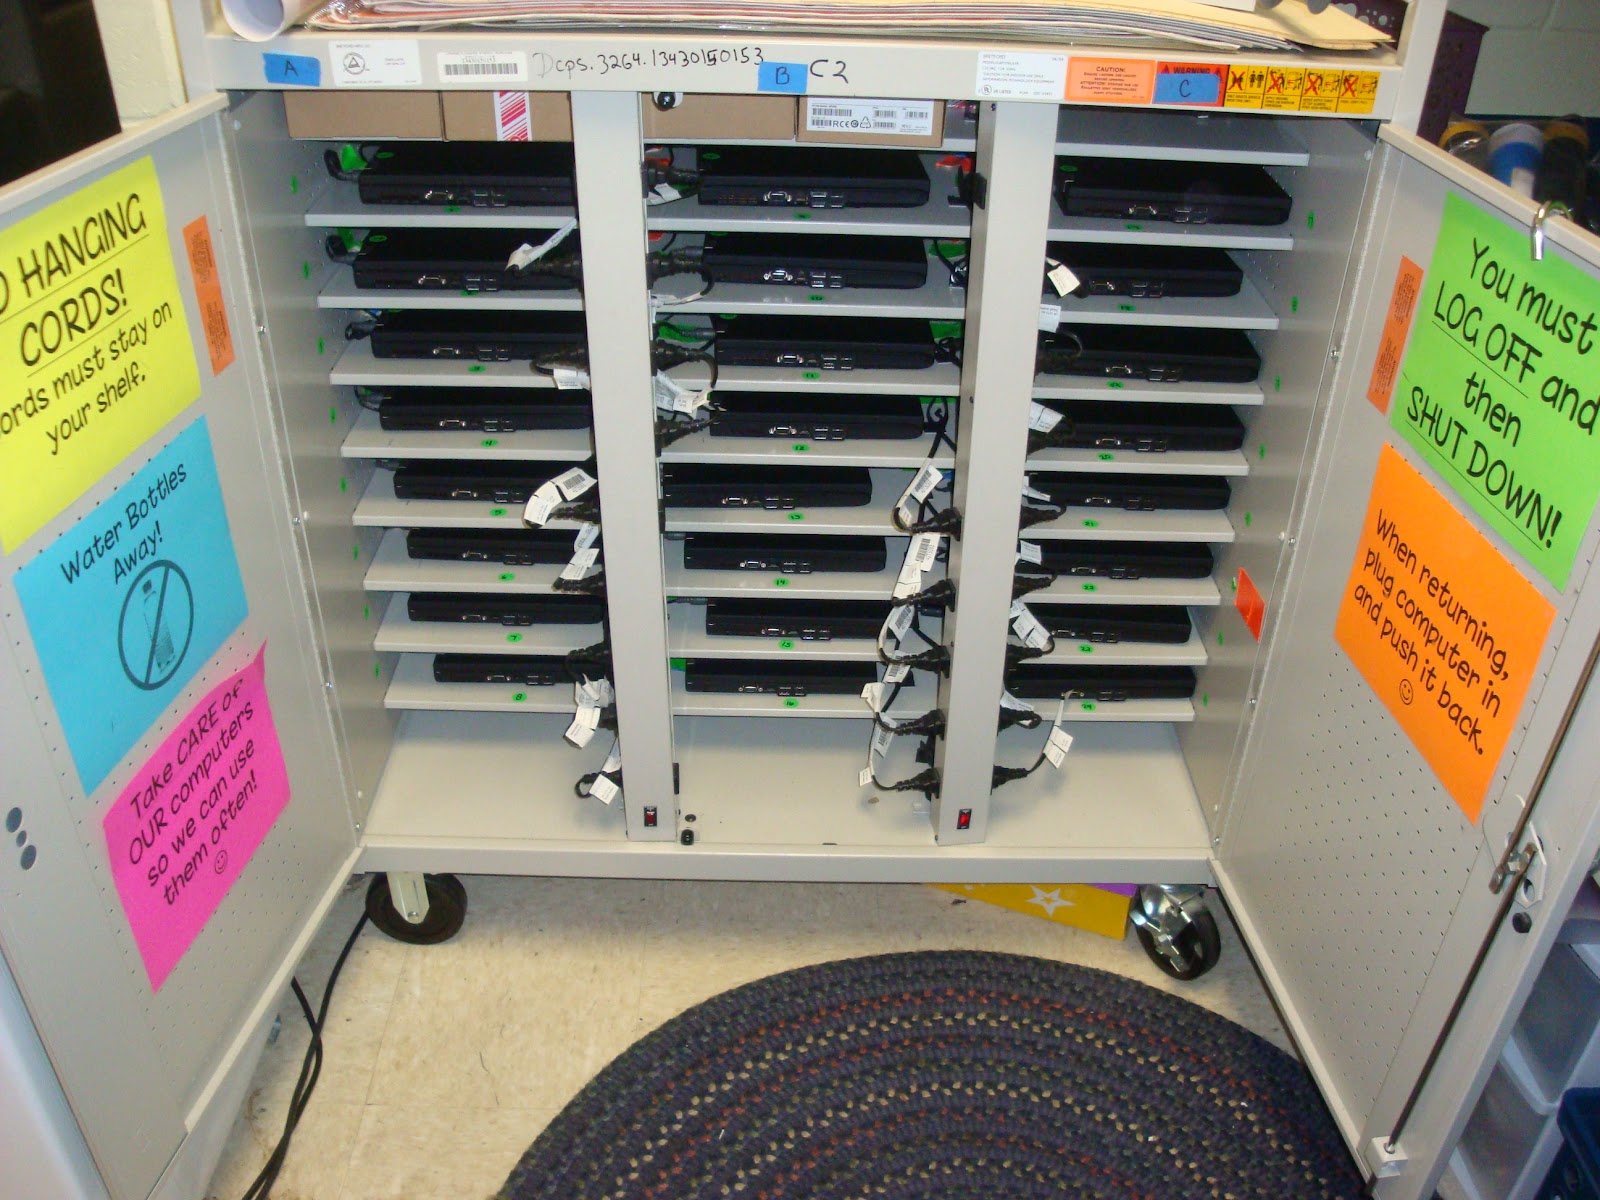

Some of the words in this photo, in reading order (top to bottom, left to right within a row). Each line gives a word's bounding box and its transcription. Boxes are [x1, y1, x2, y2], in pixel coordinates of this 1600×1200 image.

[284, 60, 298, 76] A
[776, 66, 790, 84] B
[1180, 80, 1191, 98] C
[17, 192, 147, 298] HANGING
[1470, 237, 1516, 303] You
[1516, 281, 1598, 355] must
[0, 388, 50, 435] ords
[52, 346, 105, 400] must
[109, 320, 148, 361] stay
[152, 301, 173, 330] on
[20, 267, 128, 366] CORDS!
[1434, 280, 1483, 348] LOG
[1484, 323, 1543, 384] OFF
[1540, 375, 1600, 436] and
[46, 402, 90, 456] your
[96, 360, 146, 413] shelf.
[1406, 384, 1468, 461] SHUT
[1465, 440, 1563, 549] DOWN!
[1463, 371, 1522, 448] then
[60, 522, 123, 584] Water
[124, 463, 188, 530] Bottles
[110, 520, 164, 584] Away!
[1364, 548, 1394, 600] plug
[1396, 589, 1480, 690] computer
[1482, 680, 1502, 718] in
[1376, 508, 1418, 575] When
[1420, 563, 1510, 682] returning,
[1354, 584, 1382, 626] and
[1380, 616, 1419, 672] push
[1420, 658, 1436, 693] it
[1438, 680, 1484, 756] back.
[128, 806, 168, 866] OUR
[170, 701, 254, 816] computers
[130, 761, 173, 820] Take
[177, 710, 218, 766] CARE
[222, 678, 244, 712] of
[147, 855, 169, 888] so
[171, 816, 196, 856] we
[199, 776, 228, 820] can
[230, 738, 256, 774] use
[162, 842, 209, 906] them
[210, 768, 258, 846] often!
